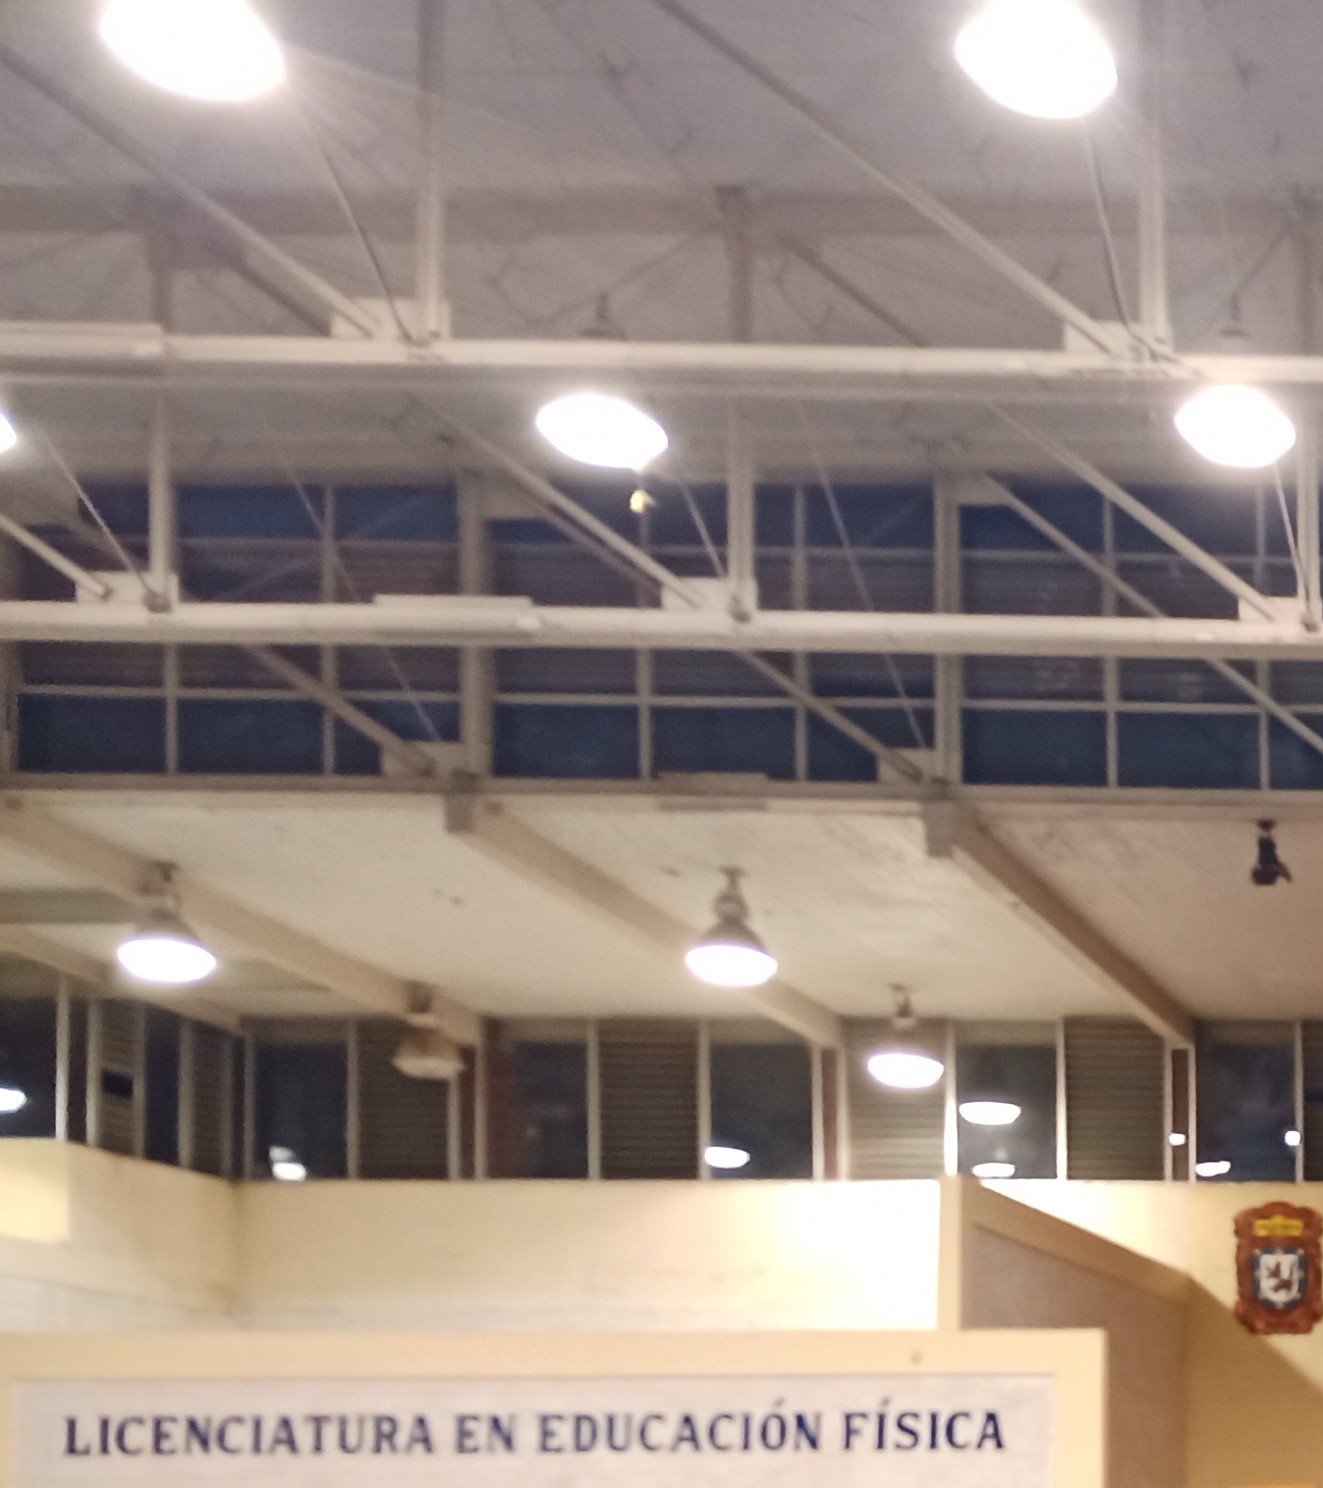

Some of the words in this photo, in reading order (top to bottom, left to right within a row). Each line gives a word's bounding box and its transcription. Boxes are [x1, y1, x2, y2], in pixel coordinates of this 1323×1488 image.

[64, 1414, 435, 1456] LICENCIATURA
[454, 1413, 516, 1455] EN
[537, 1396, 822, 1453] EDUCACIÓN
[842, 1396, 1007, 1452] FÍSICA
